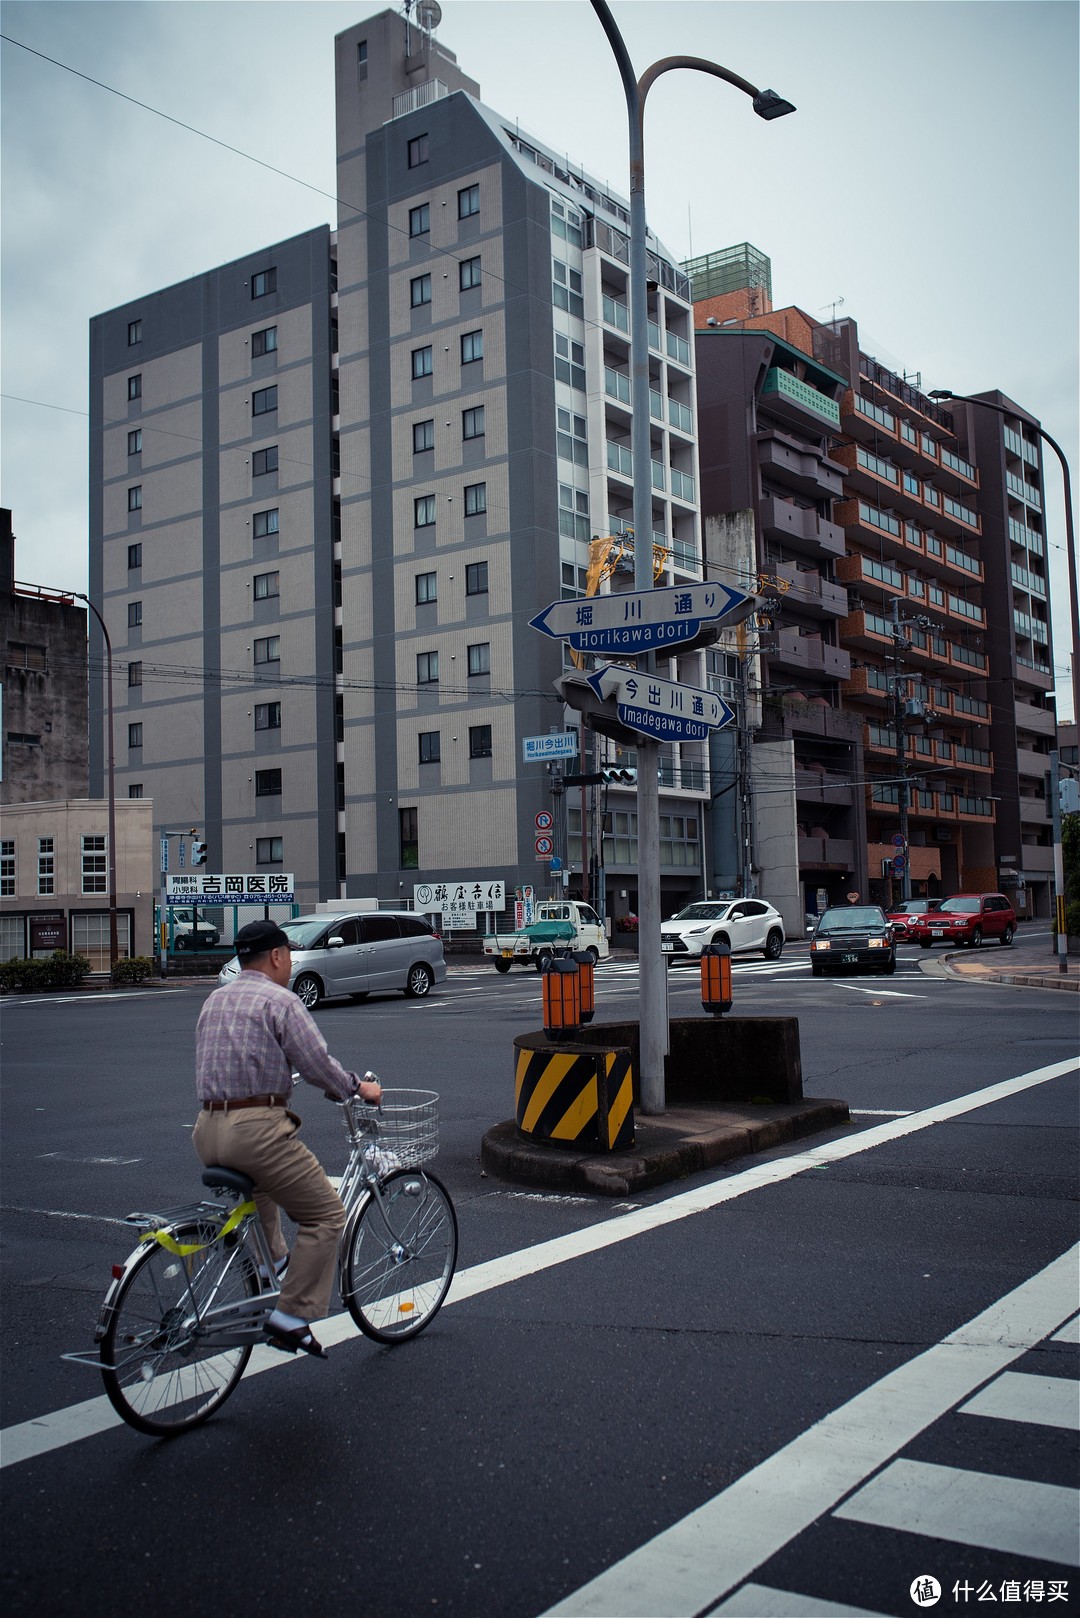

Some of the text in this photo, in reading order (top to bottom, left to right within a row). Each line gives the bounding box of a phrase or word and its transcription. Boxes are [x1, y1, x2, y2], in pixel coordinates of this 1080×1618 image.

[576, 593, 716, 626] 堀川通り
[579, 621, 690, 648] Horikawa dori
[625, 678, 718, 719] 今出川通り
[623, 705, 706, 738] Imadegawa dori
[526, 736, 573, 751] 堀川今出川
[172, 886, 198, 895] 小児科
[202, 875, 288, 893] 吉岡医院
[441, 900, 494, 911] お客様駐車場
